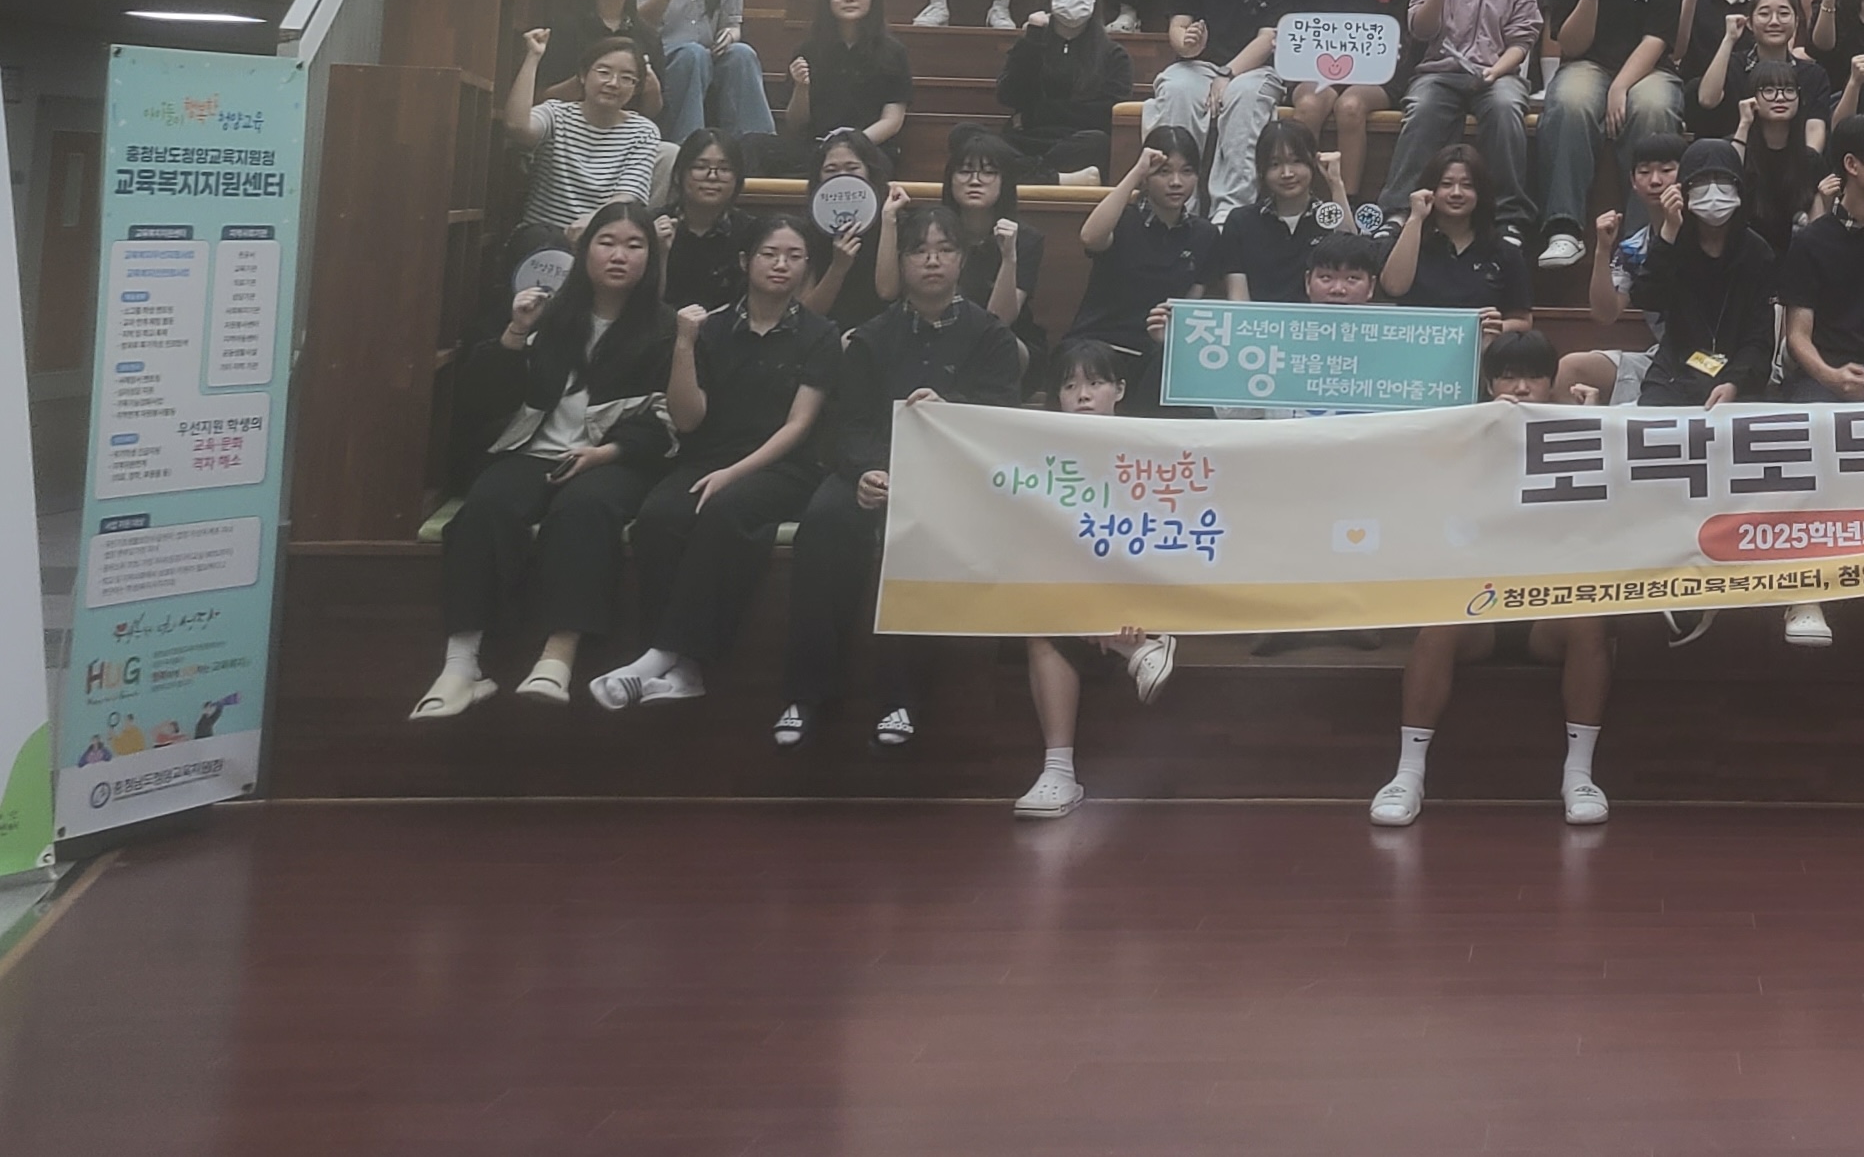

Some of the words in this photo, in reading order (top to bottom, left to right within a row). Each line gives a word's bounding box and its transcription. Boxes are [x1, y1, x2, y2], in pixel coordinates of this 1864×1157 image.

[1295, 18, 1338, 37] 마음아
[1344, 22, 1383, 40] 안녕?
[1288, 33, 1307, 53] 잘
[1312, 38, 1372, 56] 지내지?
[126, 146, 275, 166] 충청남도청양교육지원청
[114, 168, 284, 197] 교육복지지원센터
[1184, 308, 1232, 370] 청
[1236, 320, 1285, 339] 소년이
[1289, 321, 1336, 340] 힘들어
[1341, 322, 1358, 342] 할
[1361, 323, 1378, 342] 땐
[1382, 324, 1465, 345] 또래상담자
[1238, 344, 1286, 397] 양
[1290, 353, 1323, 374] 팔을
[1327, 355, 1358, 375] 벌려
[1307, 378, 1372, 397] 따뜻하게
[1377, 380, 1425, 400] 안아줄
[1428, 380, 1461, 400] 거야
[176, 419, 224, 436] 우선지원
[227, 417, 263, 431] 학생의
[992, 455, 1109, 509] 아이들이
[1115, 450, 1215, 513] 행복한
[1079, 509, 1224, 562] 청양교육
[86, 656, 142, 695] HUG
